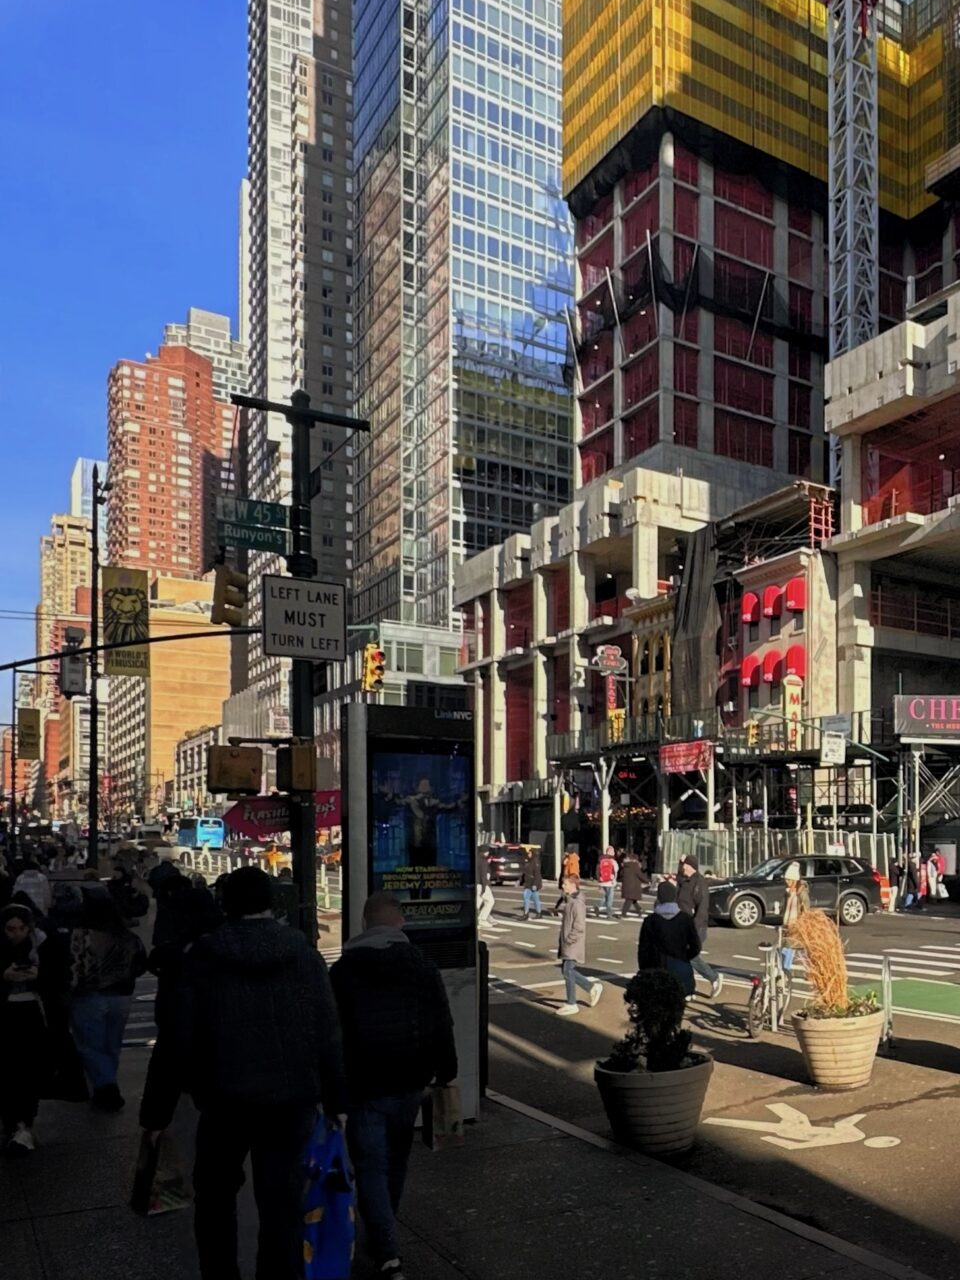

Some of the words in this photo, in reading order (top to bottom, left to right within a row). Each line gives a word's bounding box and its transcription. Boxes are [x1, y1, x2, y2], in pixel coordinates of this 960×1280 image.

[236, 502, 247, 520] W
[253, 505, 271, 523] 45
[224, 523, 282, 545] Runyon's
[271, 585, 300, 601] LEFT
[307, 590, 339, 606] LANE
[284, 609, 326, 628] MUST
[271, 633, 304, 648] TURN
[311, 636, 339, 651] LEFT
[434, 709, 473, 720] LinkNYC
[383, 881, 421, 890] JEREMY
[423, 880, 462, 889] JORDAN
